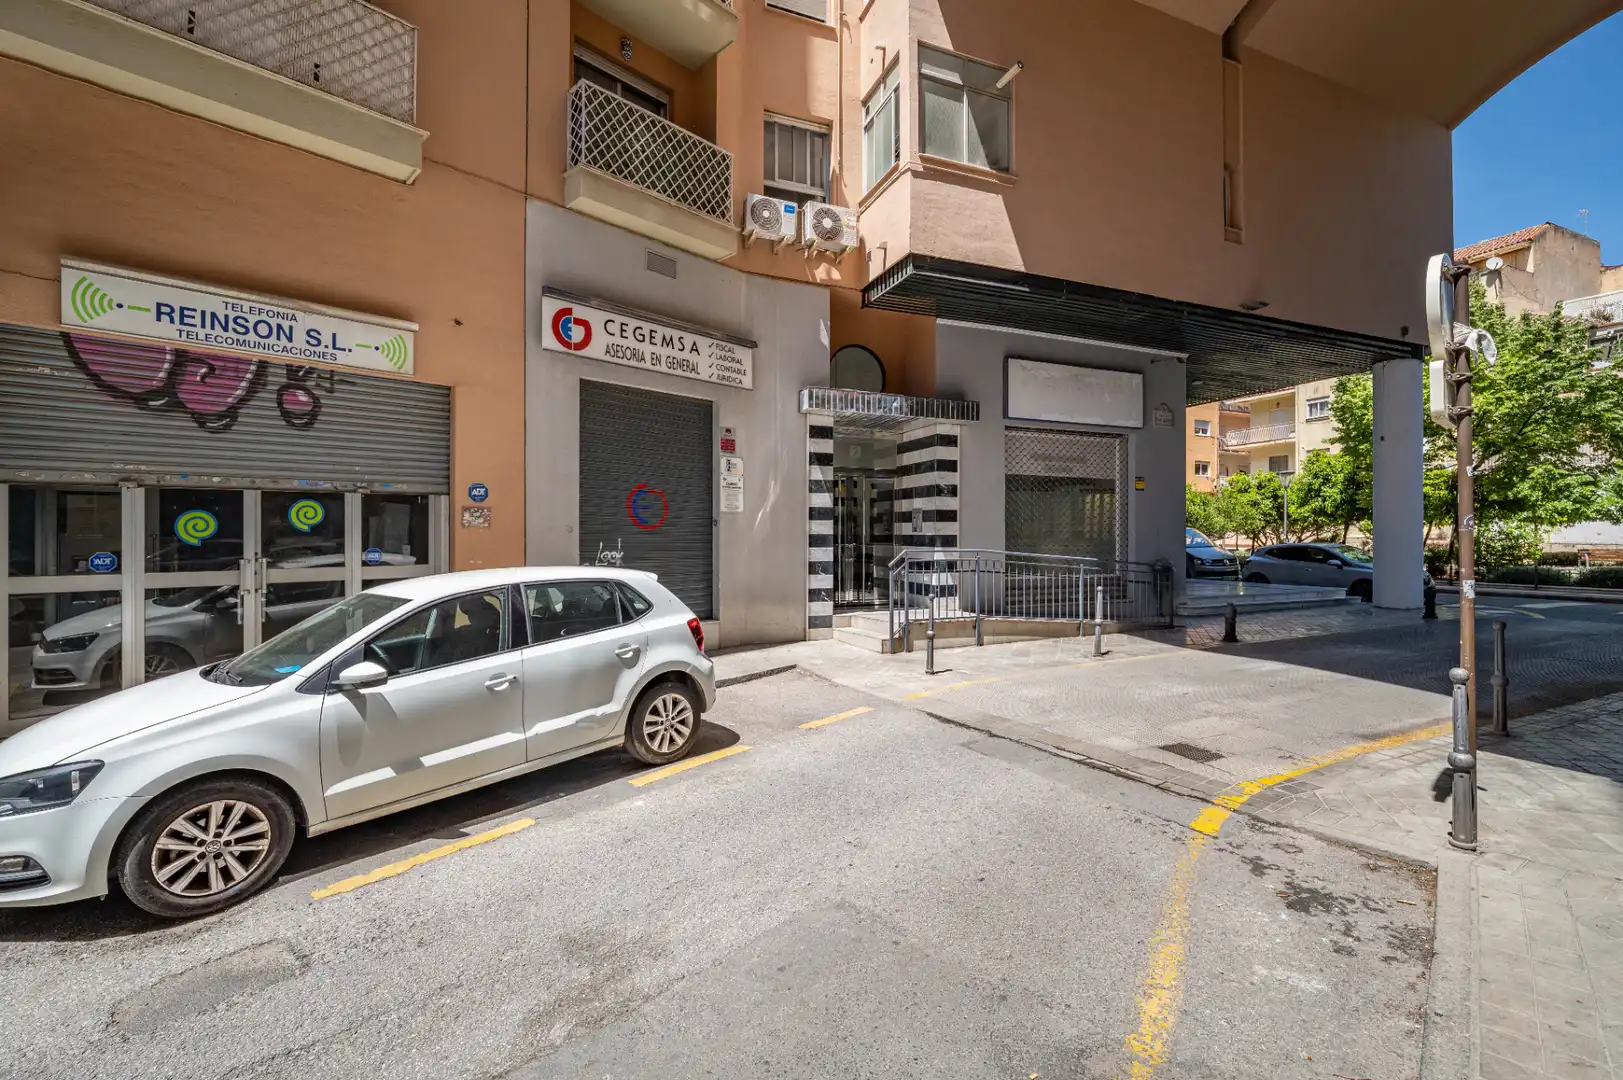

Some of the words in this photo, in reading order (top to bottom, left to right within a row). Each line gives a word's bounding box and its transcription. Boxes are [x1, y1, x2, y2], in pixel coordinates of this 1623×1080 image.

[222, 301, 299, 323] TELEFONIA
[155, 302, 294, 343] REINSON
[305, 328, 353, 353] S.L.
[176, 329, 338, 361] TELECOMUNICACIONES
[603, 319, 701, 356] CEGEMSA
[715, 343, 735, 354] FISCAL
[604, 342, 647, 364] ASESORIA
[650, 352, 662, 367] EN
[665, 355, 701, 375] GENERAL
[715, 352, 743, 366] LABORAL
[715, 363, 747, 376] CONTABLE
[471, 487, 486, 496] ADT
[94, 557, 112, 565] ADT
